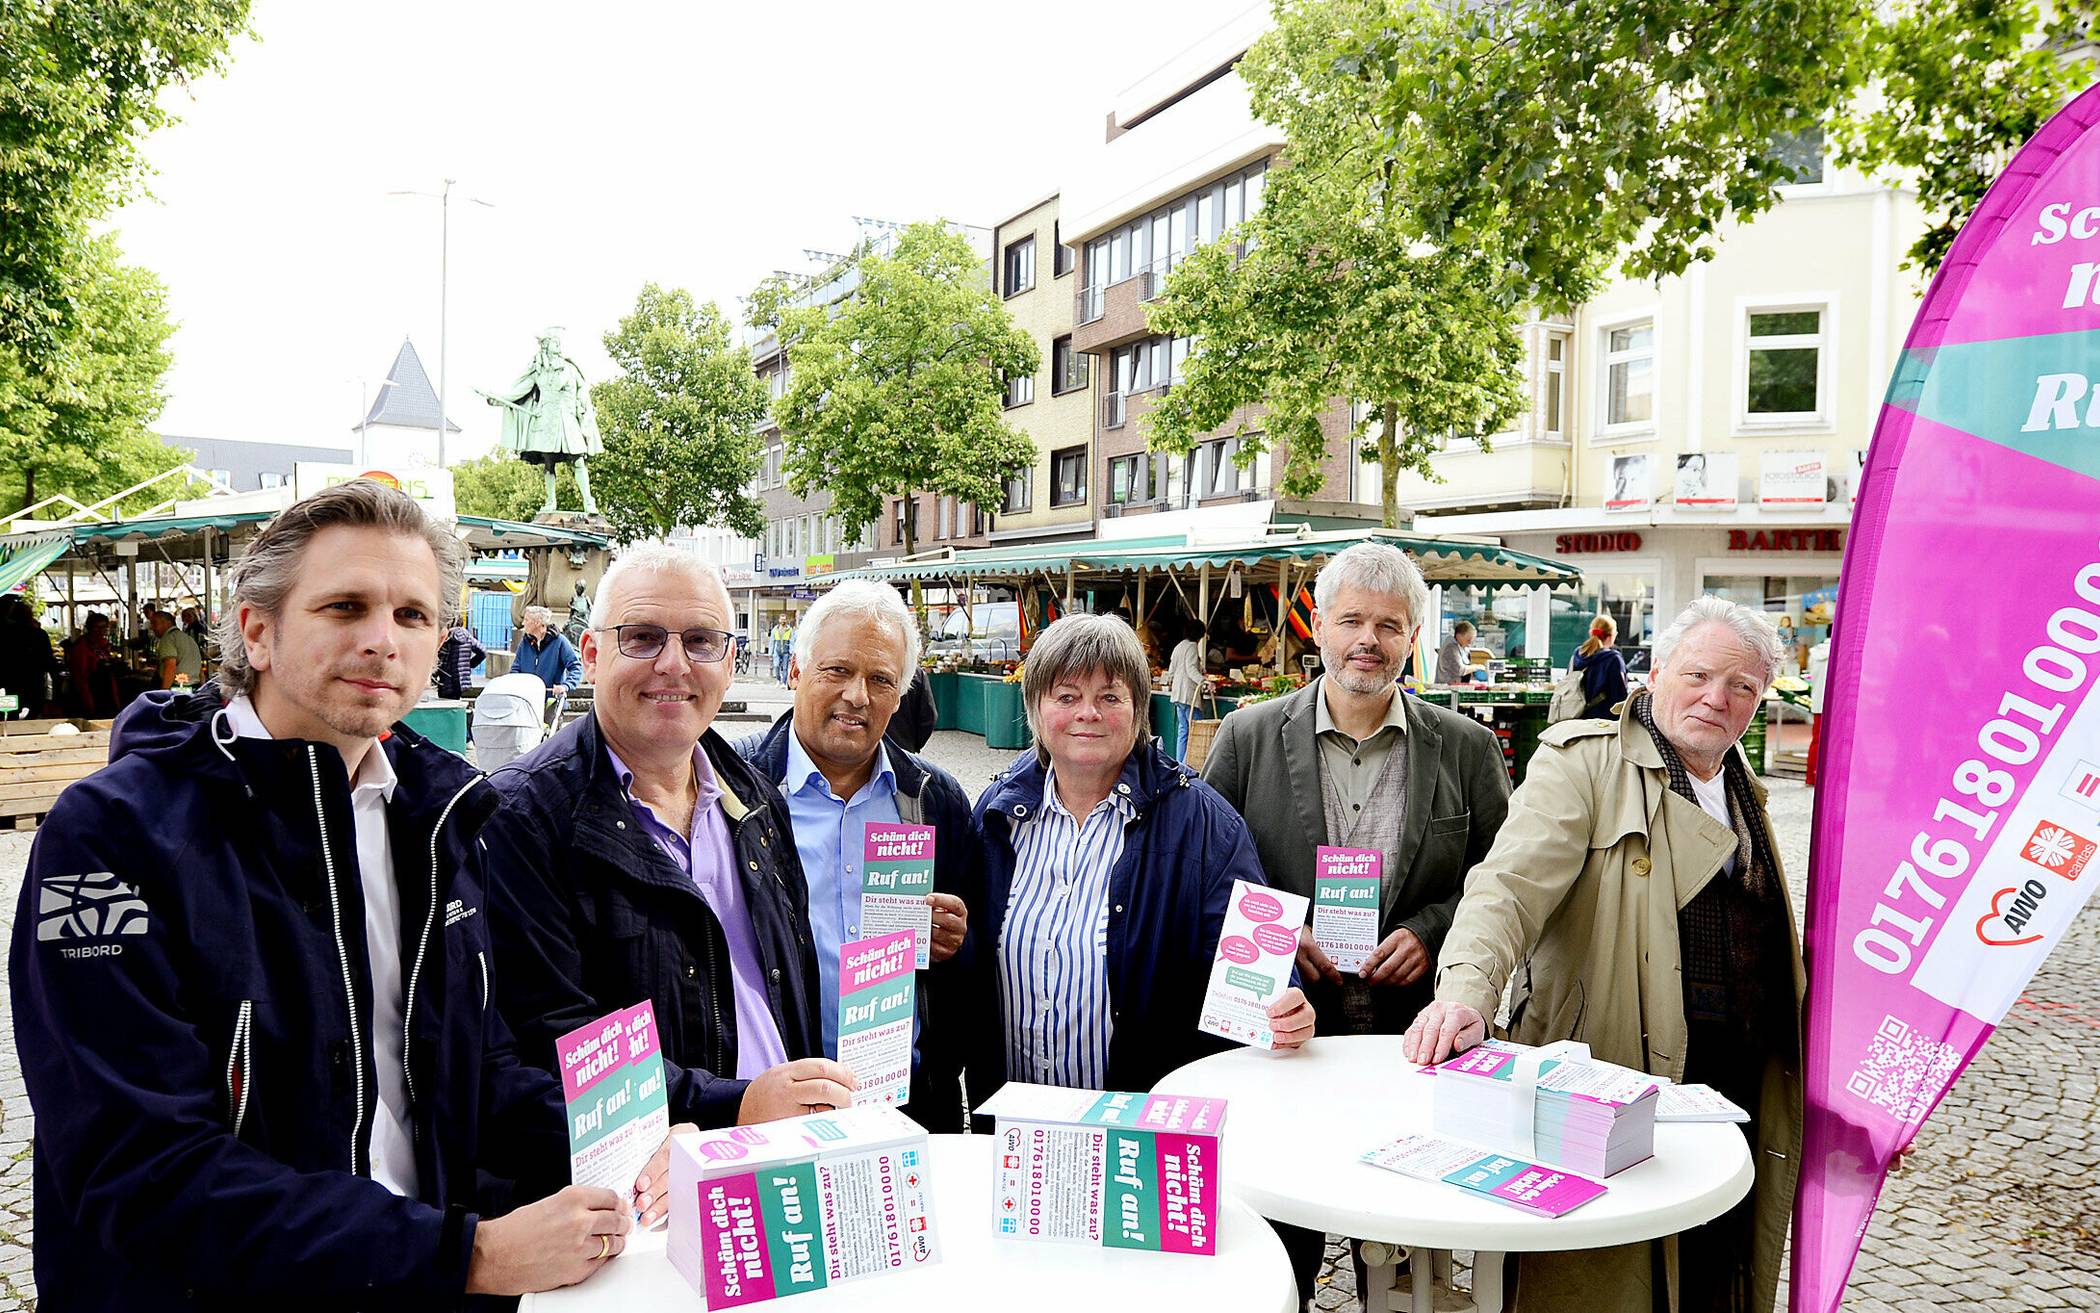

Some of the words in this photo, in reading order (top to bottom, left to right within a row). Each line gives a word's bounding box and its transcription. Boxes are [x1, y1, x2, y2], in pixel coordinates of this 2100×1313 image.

[1555, 532, 1643, 554] STUDIO
[1727, 529, 1841, 551] BARTH
[870, 832, 906, 842] Schäm
[908, 830, 931, 841] dich
[877, 842, 923, 856] nicht!
[1321, 854, 1354, 863] Schäm
[1355, 854, 1376, 863] dich
[1328, 862, 1370, 875] nicht!
[2067, 842, 2096, 880] caritas
[868, 870, 898, 888] Ruf
[901, 870, 929, 884] an!
[1320, 886, 1348, 902] Ruf
[1349, 886, 1375, 899] an!
[878, 896, 898, 904] steht
[1329, 908, 1346, 916] steht
[2003, 878, 2047, 936] AWO
[60, 944, 123, 958] TRIBORD
[846, 948, 885, 970] Schäm
[886, 936, 912, 956] dich
[854, 952, 904, 986] nicht!
[844, 996, 878, 1026] Ruf
[880, 985, 910, 1012] an!
[565, 1038, 601, 1070] Schäm
[600, 1020, 622, 1044] dich
[842, 1036, 858, 1048] Dir
[858, 1031, 877, 1044] steht
[878, 1027, 894, 1038] was
[896, 1020, 910, 1032] zu?
[576, 1040, 620, 1088] nicht!
[638, 1066, 662, 1101] an!
[574, 1097, 605, 1141] Ruf
[606, 1078, 631, 1116] an!
[575, 1153, 590, 1168] Dir
[590, 1142, 608, 1160] steht
[608, 1135, 624, 1148] was
[1092, 1134, 1102, 1153] Dir
[820, 1166, 831, 1189] zu?
[1091, 1155, 1102, 1186] steht
[1114, 1137, 1144, 1190] Ruf
[1186, 1143, 1204, 1204] Schäm
[708, 1186, 730, 1229] dich
[772, 1176, 804, 1224] an!
[824, 1192, 834, 1220] was
[1090, 1190, 1098, 1214] was
[1164, 1154, 1190, 1235] nicht!
[1088, 1218, 1098, 1240] zu?
[1120, 1193, 1145, 1242] an!
[1190, 1207, 1207, 1248] dich
[728, 1196, 764, 1280] nicht!
[826, 1222, 838, 1256] steht
[717, 1231, 742, 1297] Schäm
[782, 1230, 815, 1284] Ruf
[830, 1260, 841, 1280] Dir
